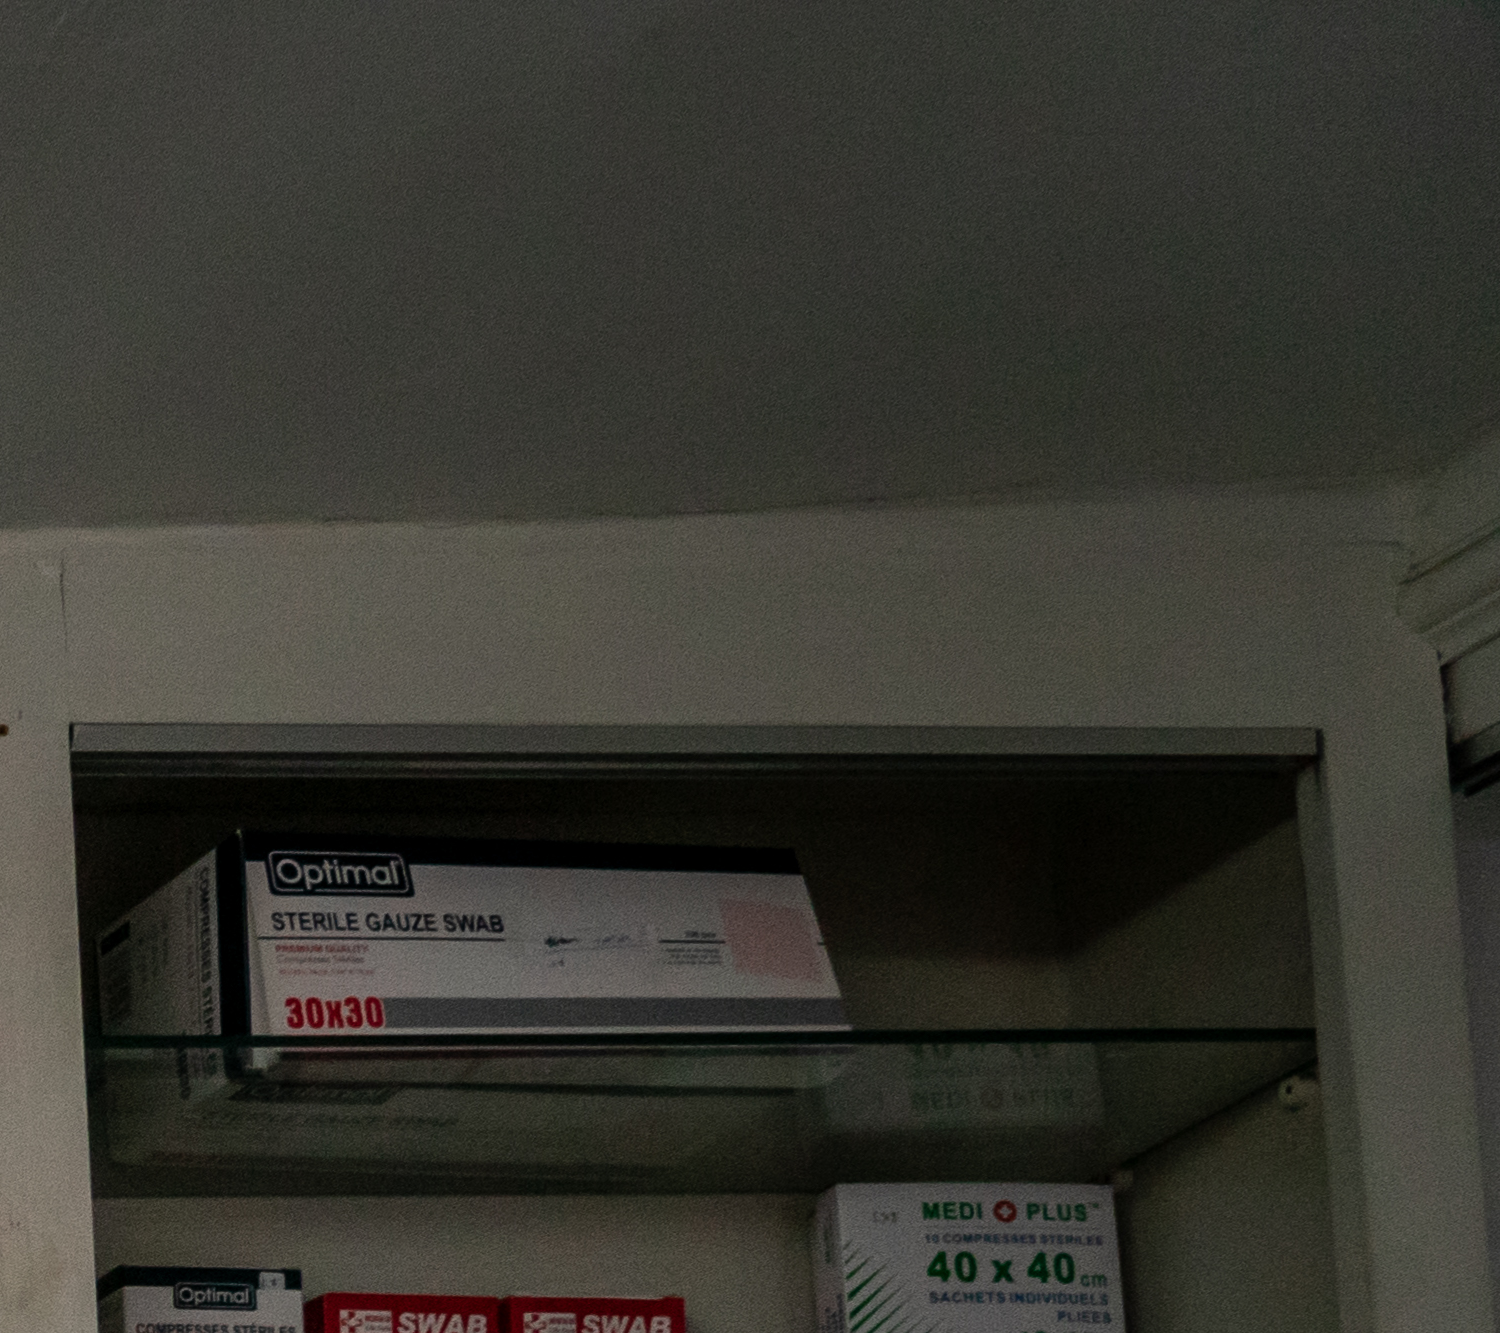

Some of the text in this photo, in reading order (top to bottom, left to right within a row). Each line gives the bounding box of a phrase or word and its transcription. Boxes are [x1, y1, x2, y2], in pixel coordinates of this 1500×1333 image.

[274, 858, 401, 892] Optimal
[271, 911, 505, 934] STERILE GAUZE SWAB
[285, 997, 384, 1029] 30x30
[922, 1201, 983, 1220] MEDI
[943, 1234, 1036, 1245] COMPRESSES
[927, 1251, 978, 1282] 40
[992, 1260, 1014, 1283] x
[1027, 1252, 1075, 1283] 40
[179, 1287, 250, 1307] Optimal
[929, 1291, 1109, 1306] SACHETS INDIVIDUELS
